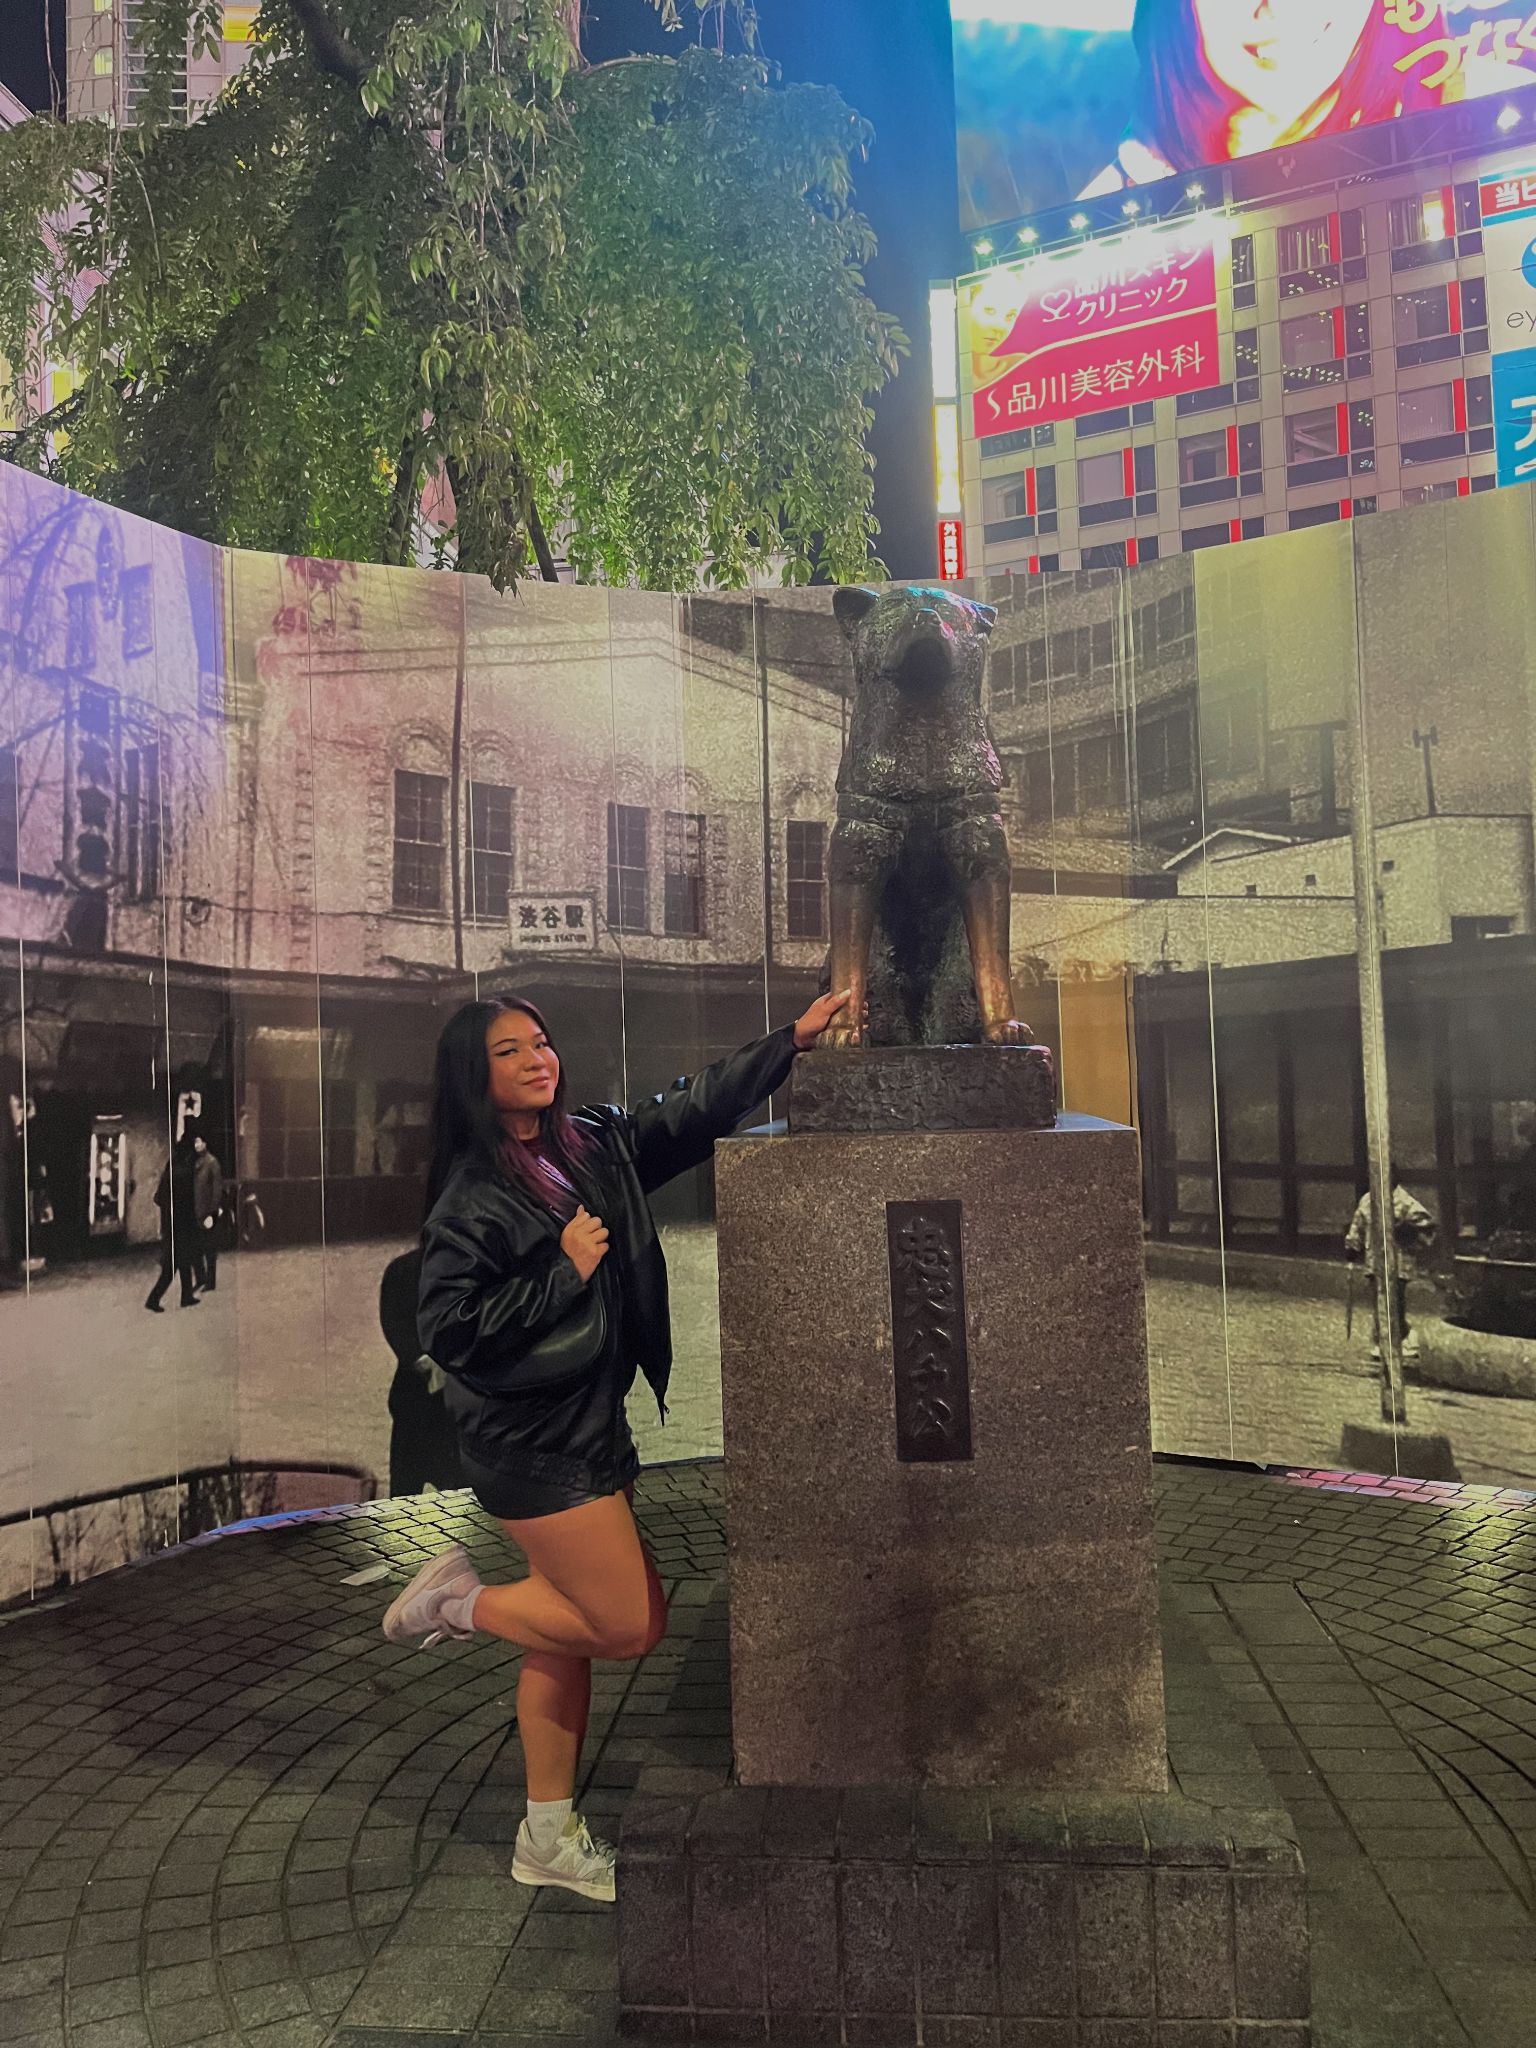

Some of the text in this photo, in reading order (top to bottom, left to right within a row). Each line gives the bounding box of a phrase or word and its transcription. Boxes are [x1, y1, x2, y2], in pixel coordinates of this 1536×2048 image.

[1076, 277, 1187, 325] クリニック
[1007, 341, 1205, 416] 品川美容外科
